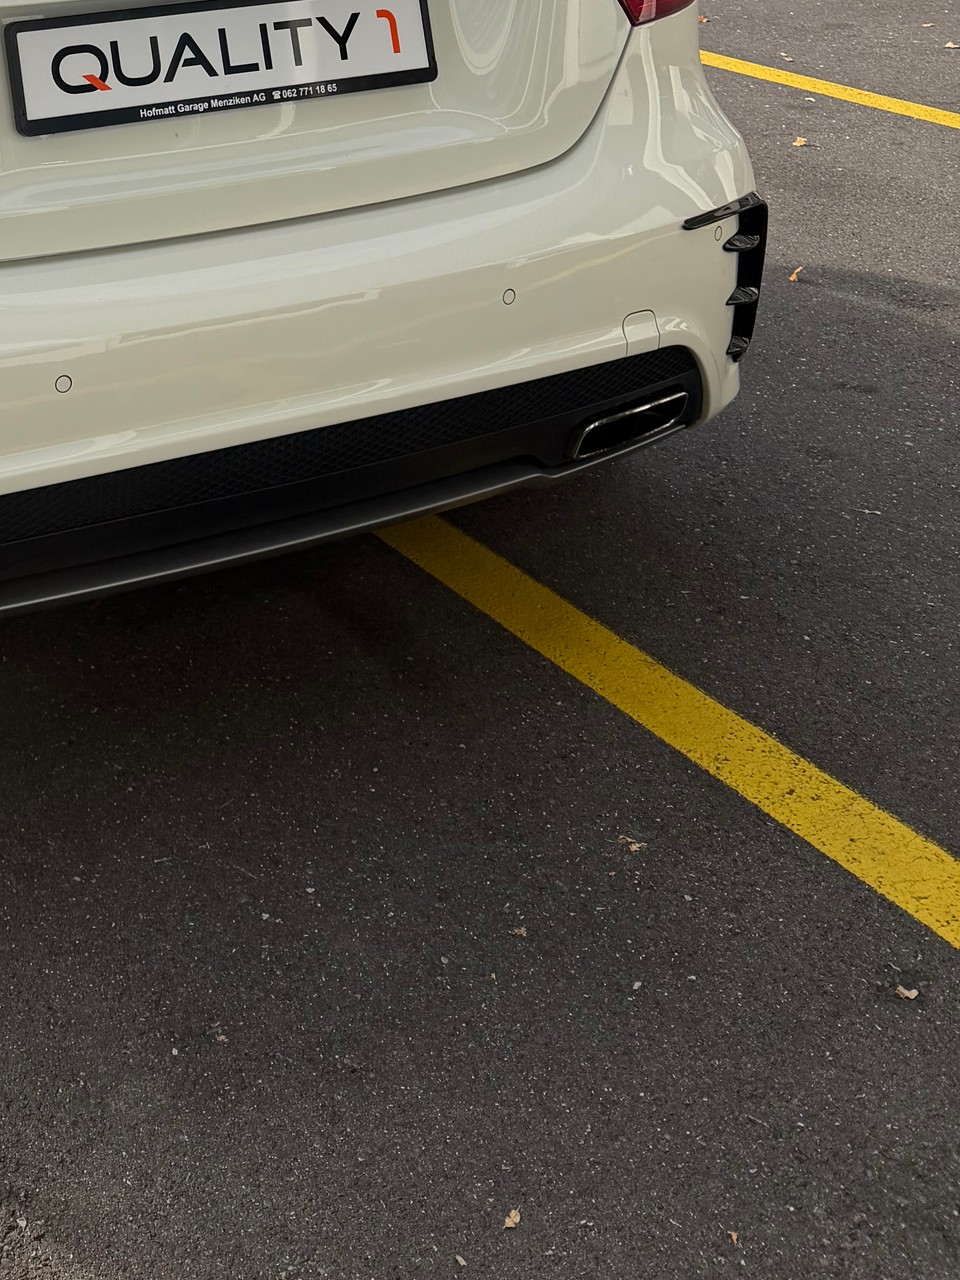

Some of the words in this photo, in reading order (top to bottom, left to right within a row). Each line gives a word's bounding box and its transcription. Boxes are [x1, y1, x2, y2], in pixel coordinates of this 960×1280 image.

[50, 11, 361, 95] QUALITY
[375, 8, 401, 54] 1
[140, 104, 176, 118] Hofmatt
[177, 101, 209, 114] Garage
[210, 95, 251, 109] Menziken
[252, 92, 267, 104] AG
[282, 88, 298, 99] 062
[299, 86, 314, 97] 771
[315, 85, 326, 95] 18
[327, 83, 338, 93] 65
